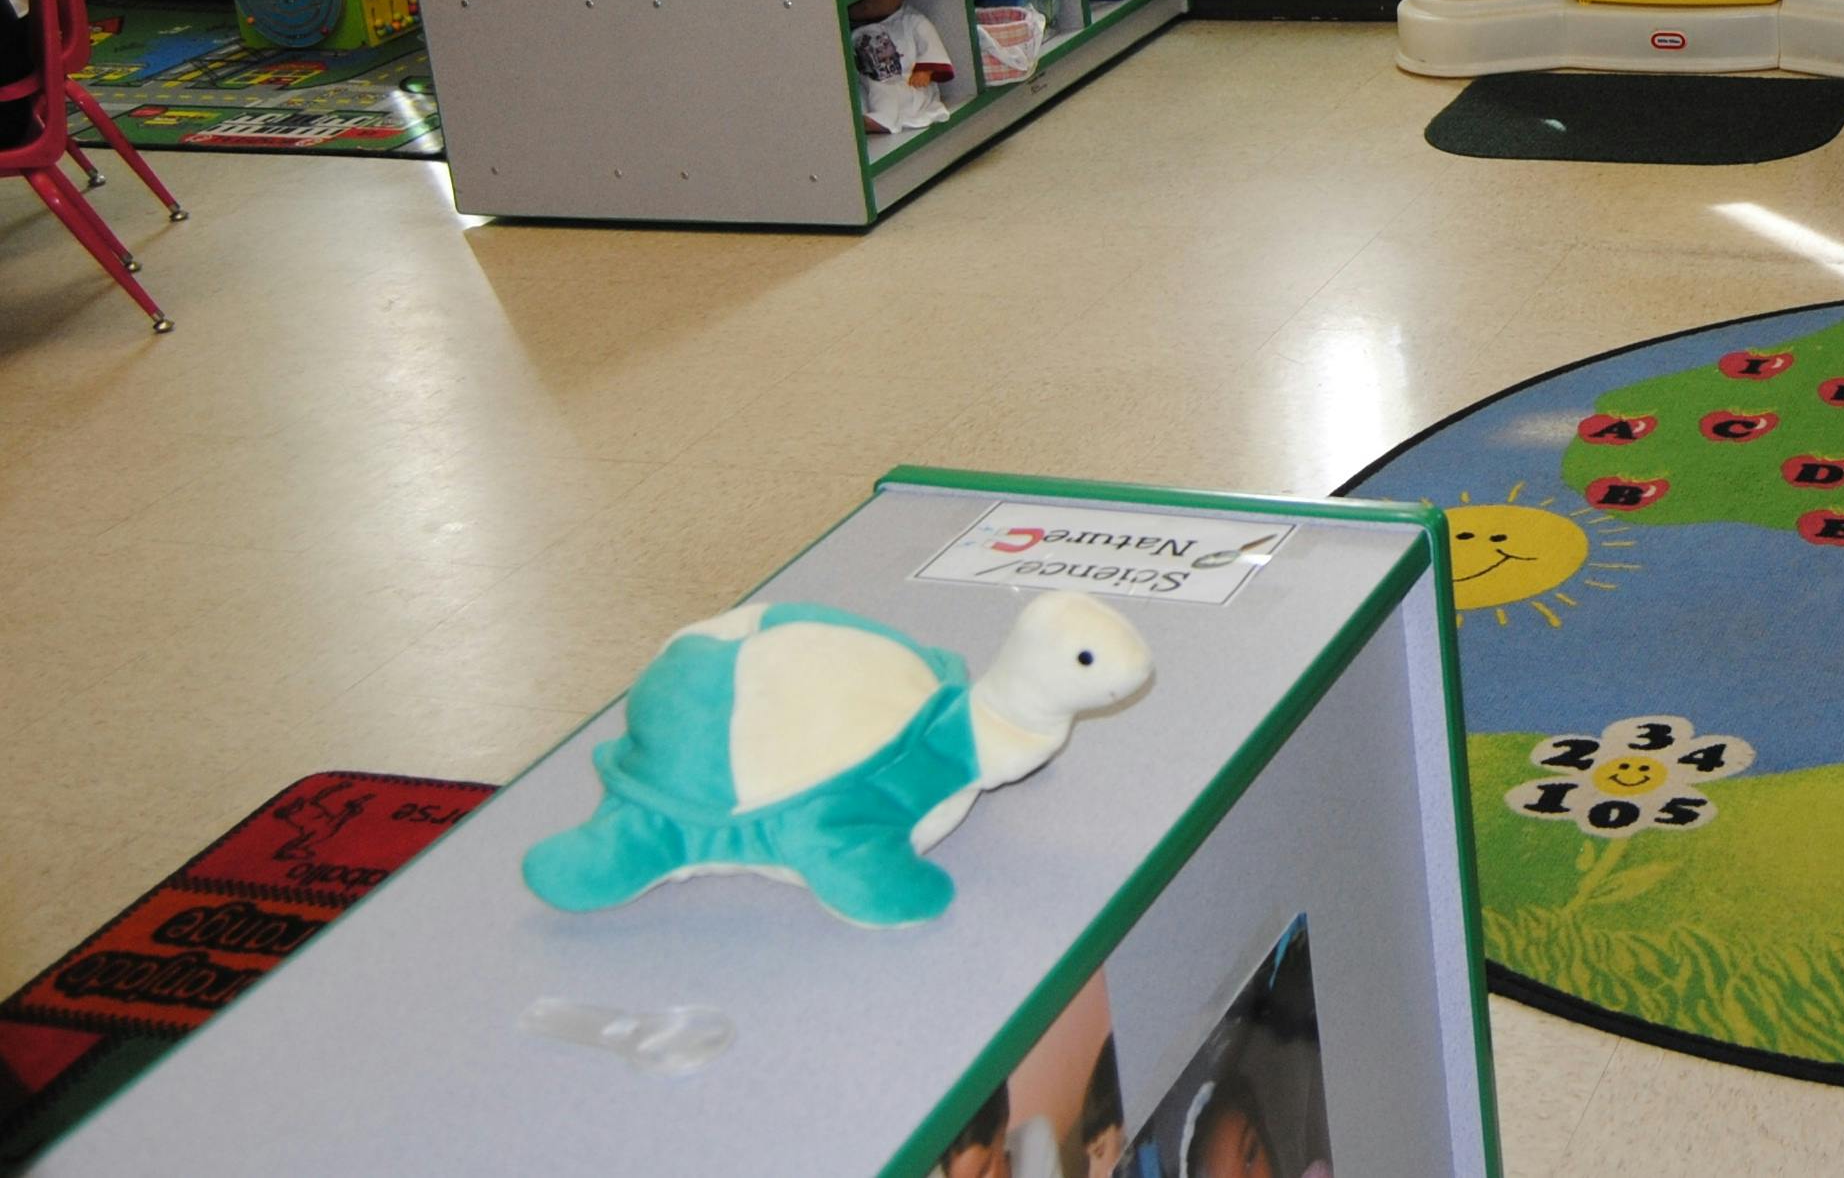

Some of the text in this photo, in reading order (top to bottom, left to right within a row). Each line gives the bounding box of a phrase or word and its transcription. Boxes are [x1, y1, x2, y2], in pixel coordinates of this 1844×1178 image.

[1744, 360, 1763, 373] I
[1595, 422, 1633, 439] A
[1714, 421, 1756, 438] C
[1796, 464, 1844, 483] D
[1601, 486, 1642, 505] B
[1042, 529, 1199, 558] Nature
[975, 559, 1190, 591] Science/
[1629, 724, 1673, 750] 3
[1542, 740, 1599, 770] 2
[1679, 744, 1725, 771] 4
[1524, 784, 1577, 813] 1
[1655, 798, 1706, 825] 5
[391, 803, 468, 825] rse
[286, 862, 391, 889] aballo
[165, 900, 315, 952] range
